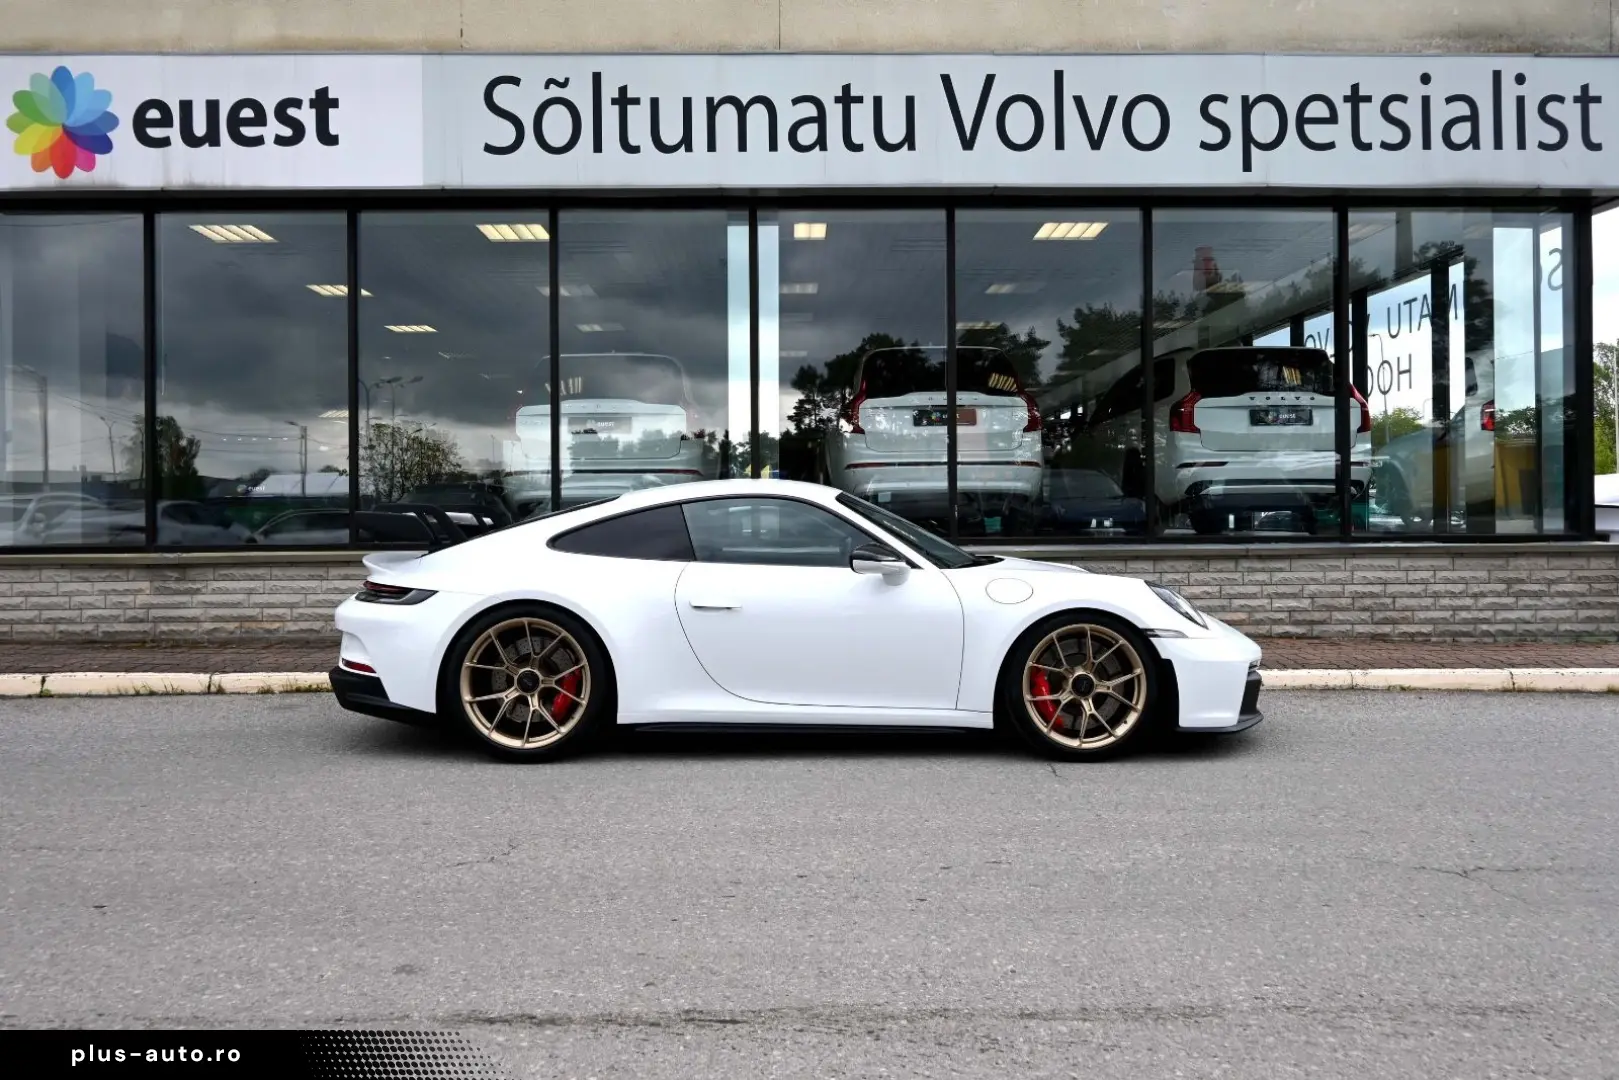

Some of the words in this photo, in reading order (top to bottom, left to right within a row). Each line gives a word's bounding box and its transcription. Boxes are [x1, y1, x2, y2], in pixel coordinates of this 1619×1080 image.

[132, 85, 340, 149] euest
[483, 71, 917, 156] Sõltumatu
[939, 69, 1171, 152] Volvo
[1199, 69, 1603, 173] spetsialist
